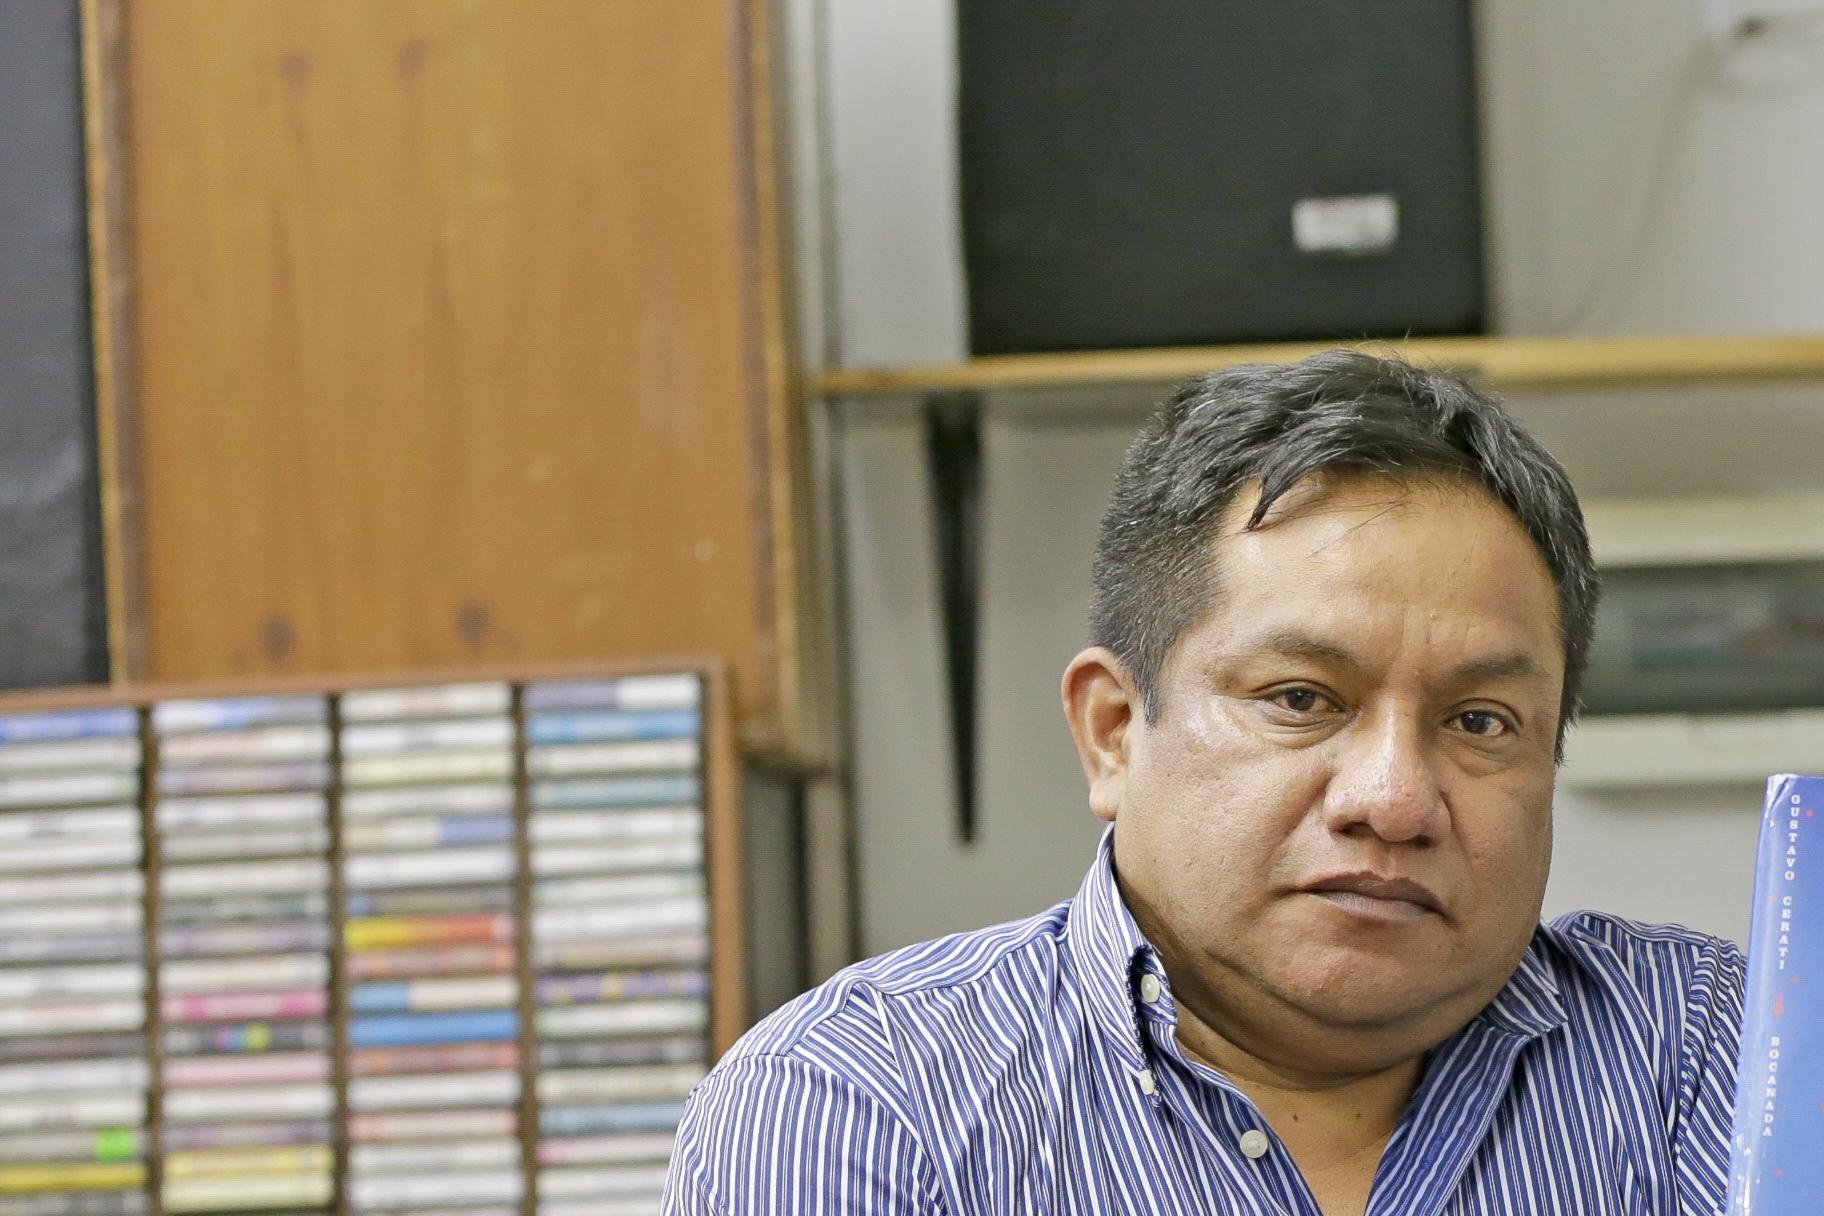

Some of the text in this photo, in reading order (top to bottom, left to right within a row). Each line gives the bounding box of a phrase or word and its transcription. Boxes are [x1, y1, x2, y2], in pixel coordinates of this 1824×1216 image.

[1762, 794, 1801, 1136] GUSTAVO CERATI BOCANADA
